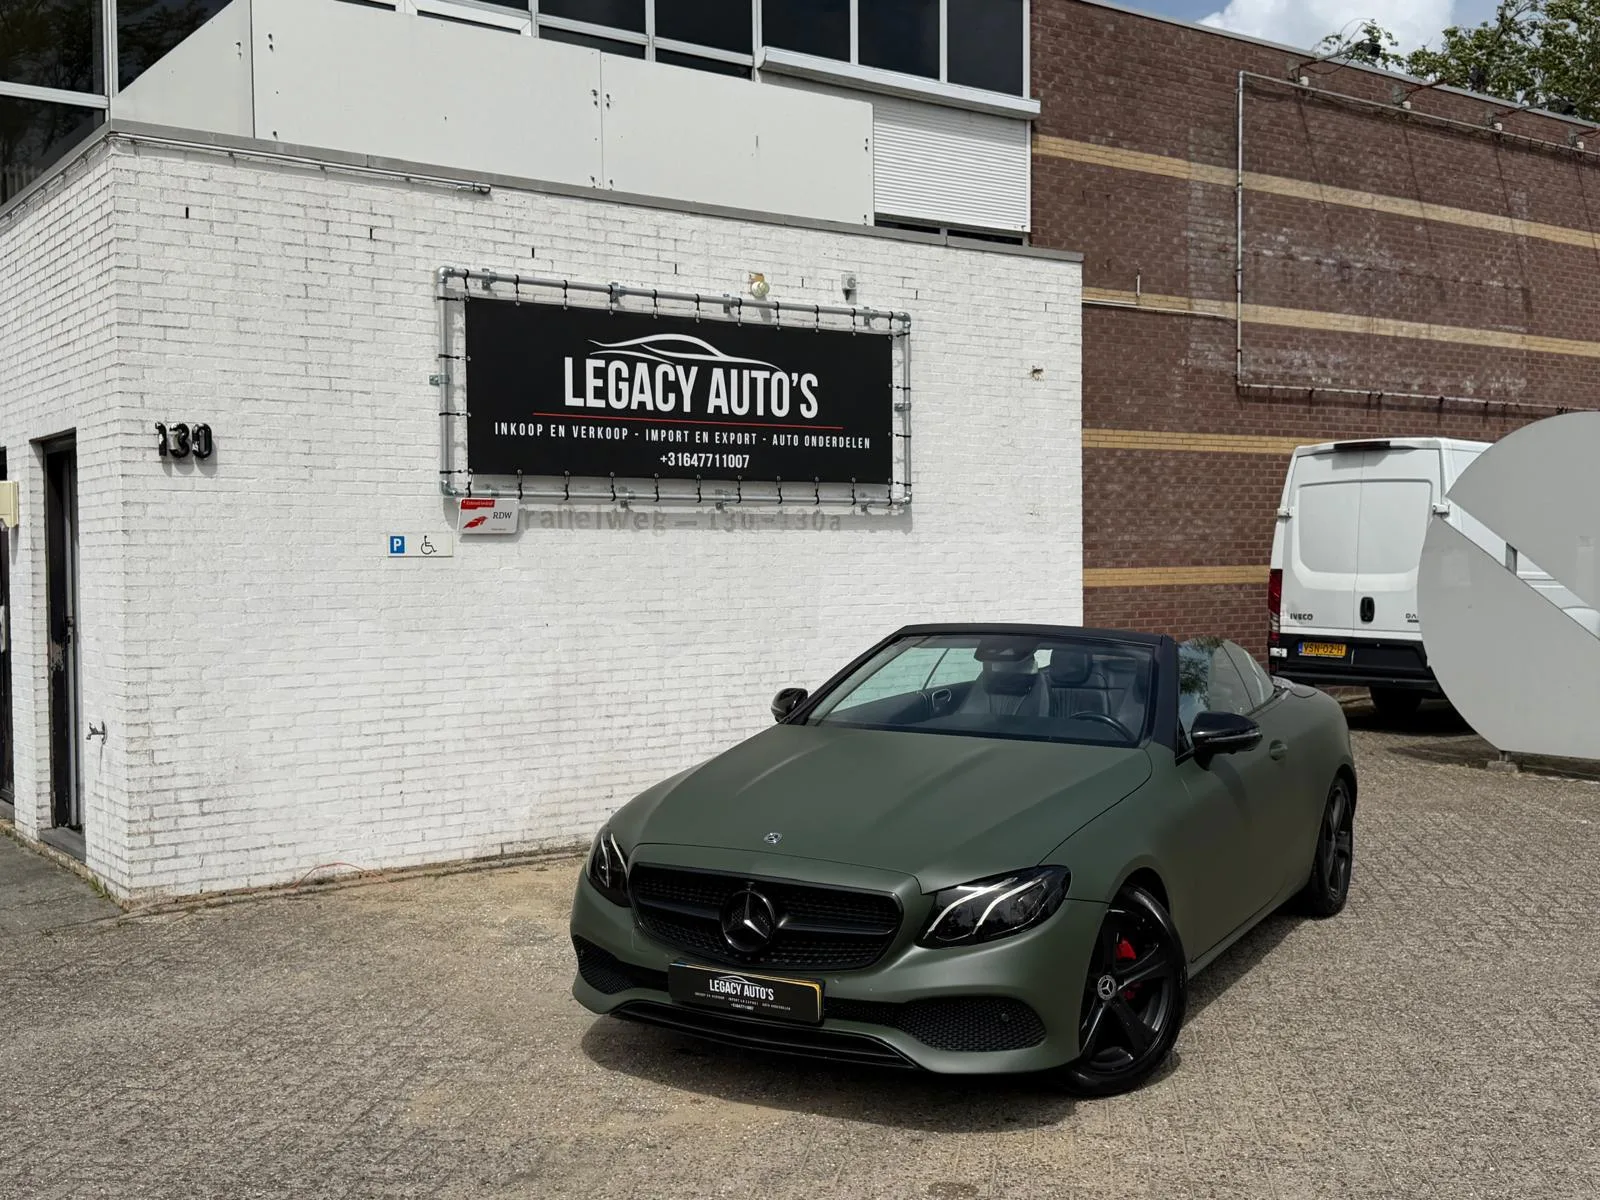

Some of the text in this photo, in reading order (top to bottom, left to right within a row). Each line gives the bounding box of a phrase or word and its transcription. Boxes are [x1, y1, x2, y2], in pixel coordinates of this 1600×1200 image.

[564, 356, 819, 419] LEGACY AUTO'S
[155, 422, 212, 458] 130
[494, 422, 543, 437] INKOOP
[550, 424, 566, 438] EN
[572, 425, 629, 440] VERKOOP
[645, 428, 689, 442] IMPORT
[695, 431, 709, 443] EN
[714, 431, 757, 445] EXPORT
[772, 434, 799, 446] AUTO
[804, 435, 871, 449] ONDERDELEN
[659, 452, 750, 468] +31647711007
[492, 511, 512, 520] RDW
[393, 538, 402, 552] P
[1290, 612, 1313, 621] IVECO
[709, 978, 742, 996] LEGACY
[743, 984, 774, 1001] AUTO'S
